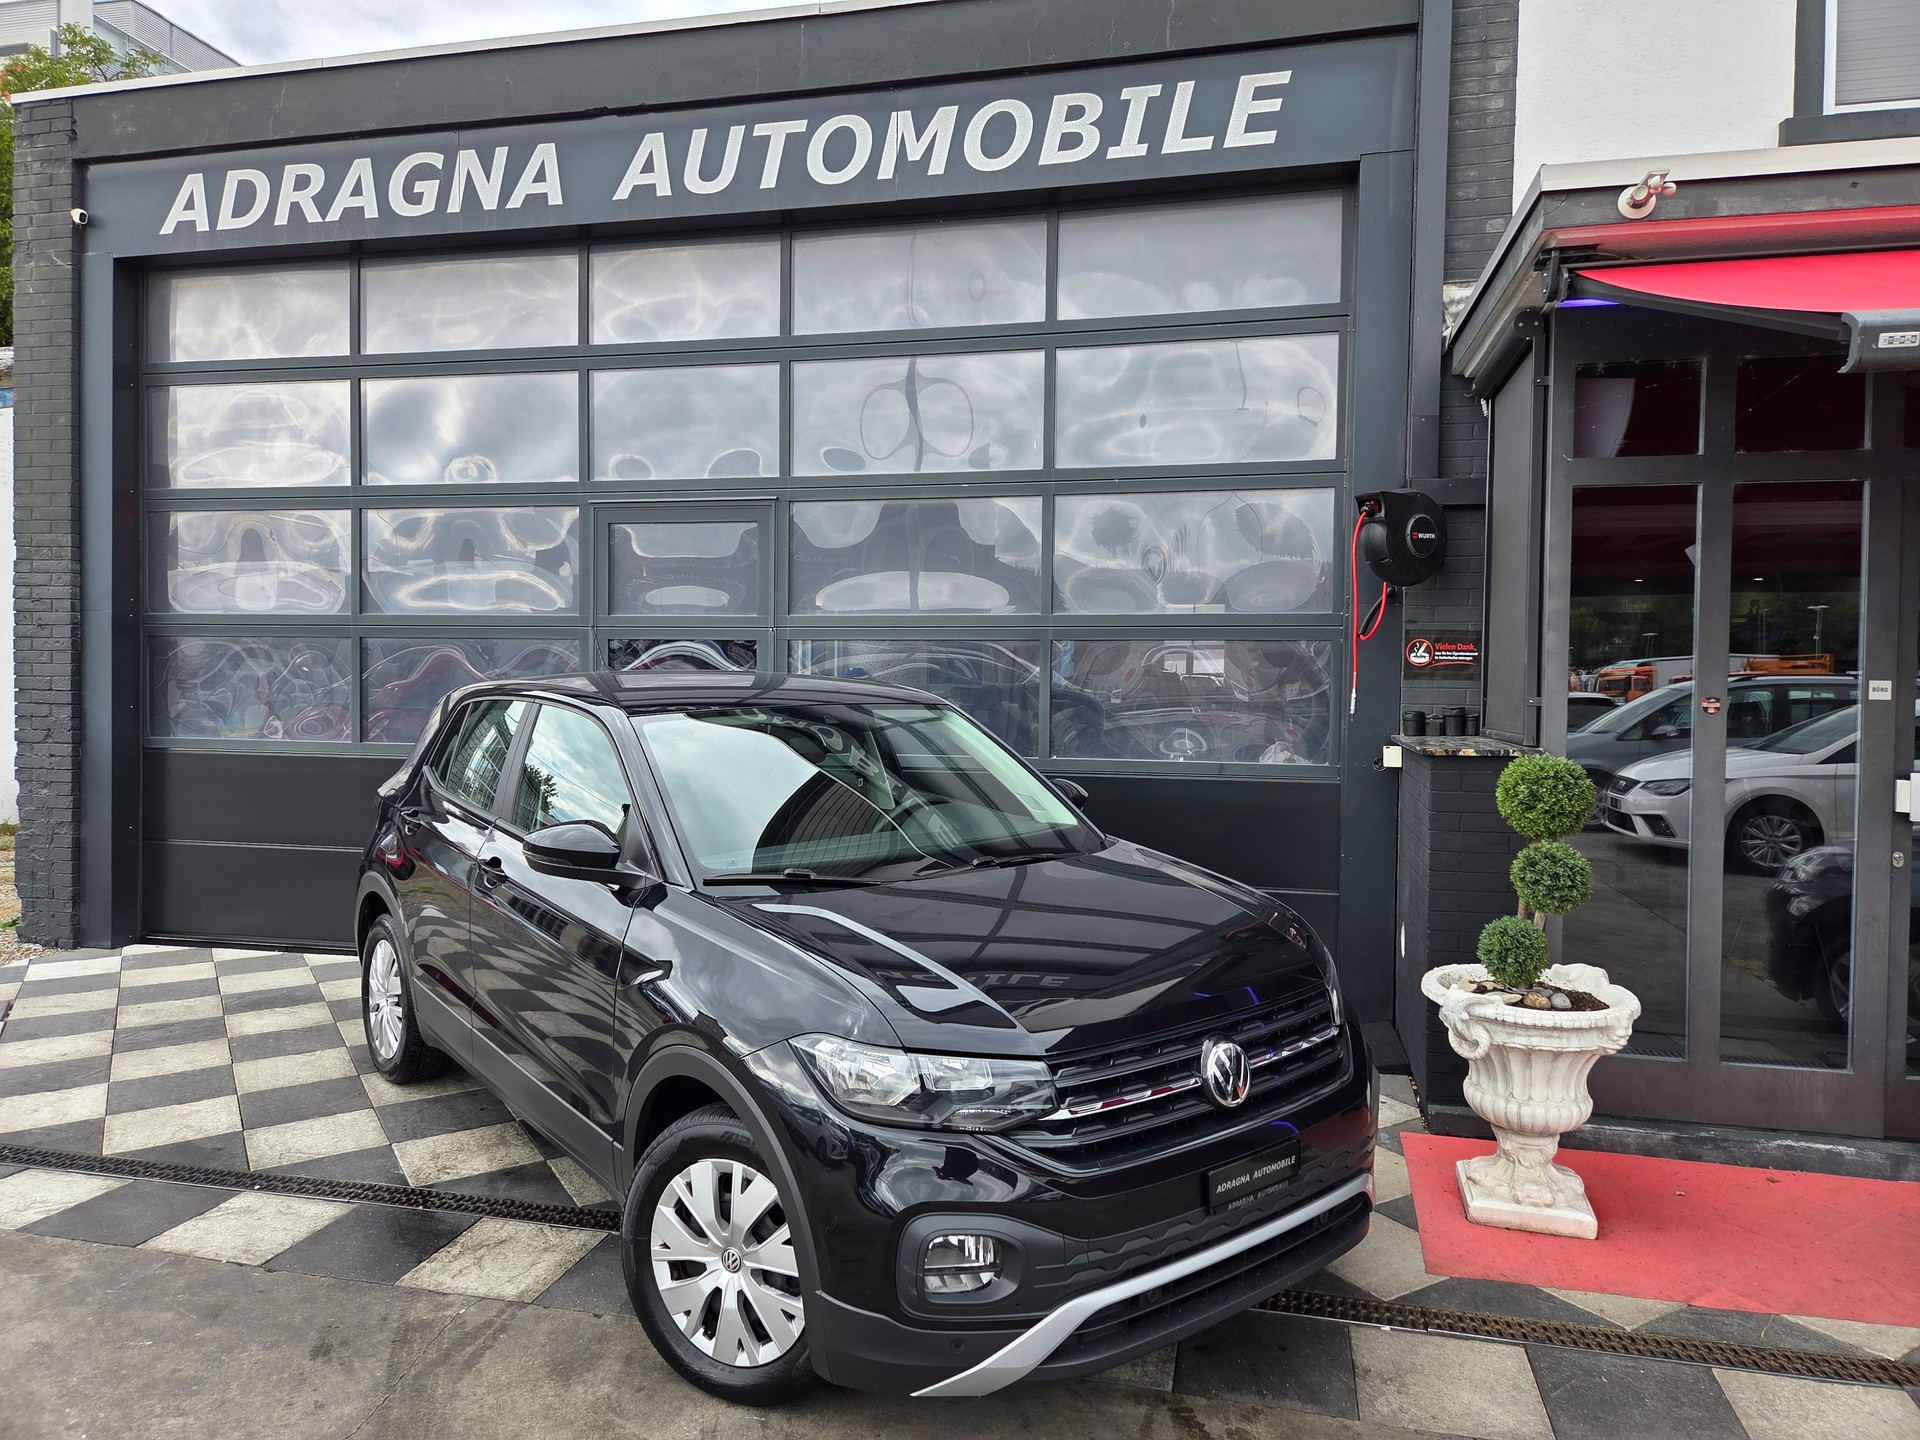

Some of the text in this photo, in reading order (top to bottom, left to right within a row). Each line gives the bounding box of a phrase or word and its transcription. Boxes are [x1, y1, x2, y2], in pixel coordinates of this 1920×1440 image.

[159, 70, 1292, 235] ADRAGNA AUTOMOBILE
[1435, 642, 1456, 650] Vielen
[1216, 1155, 1296, 1194] ADRAGNA AUTOMOBILE
